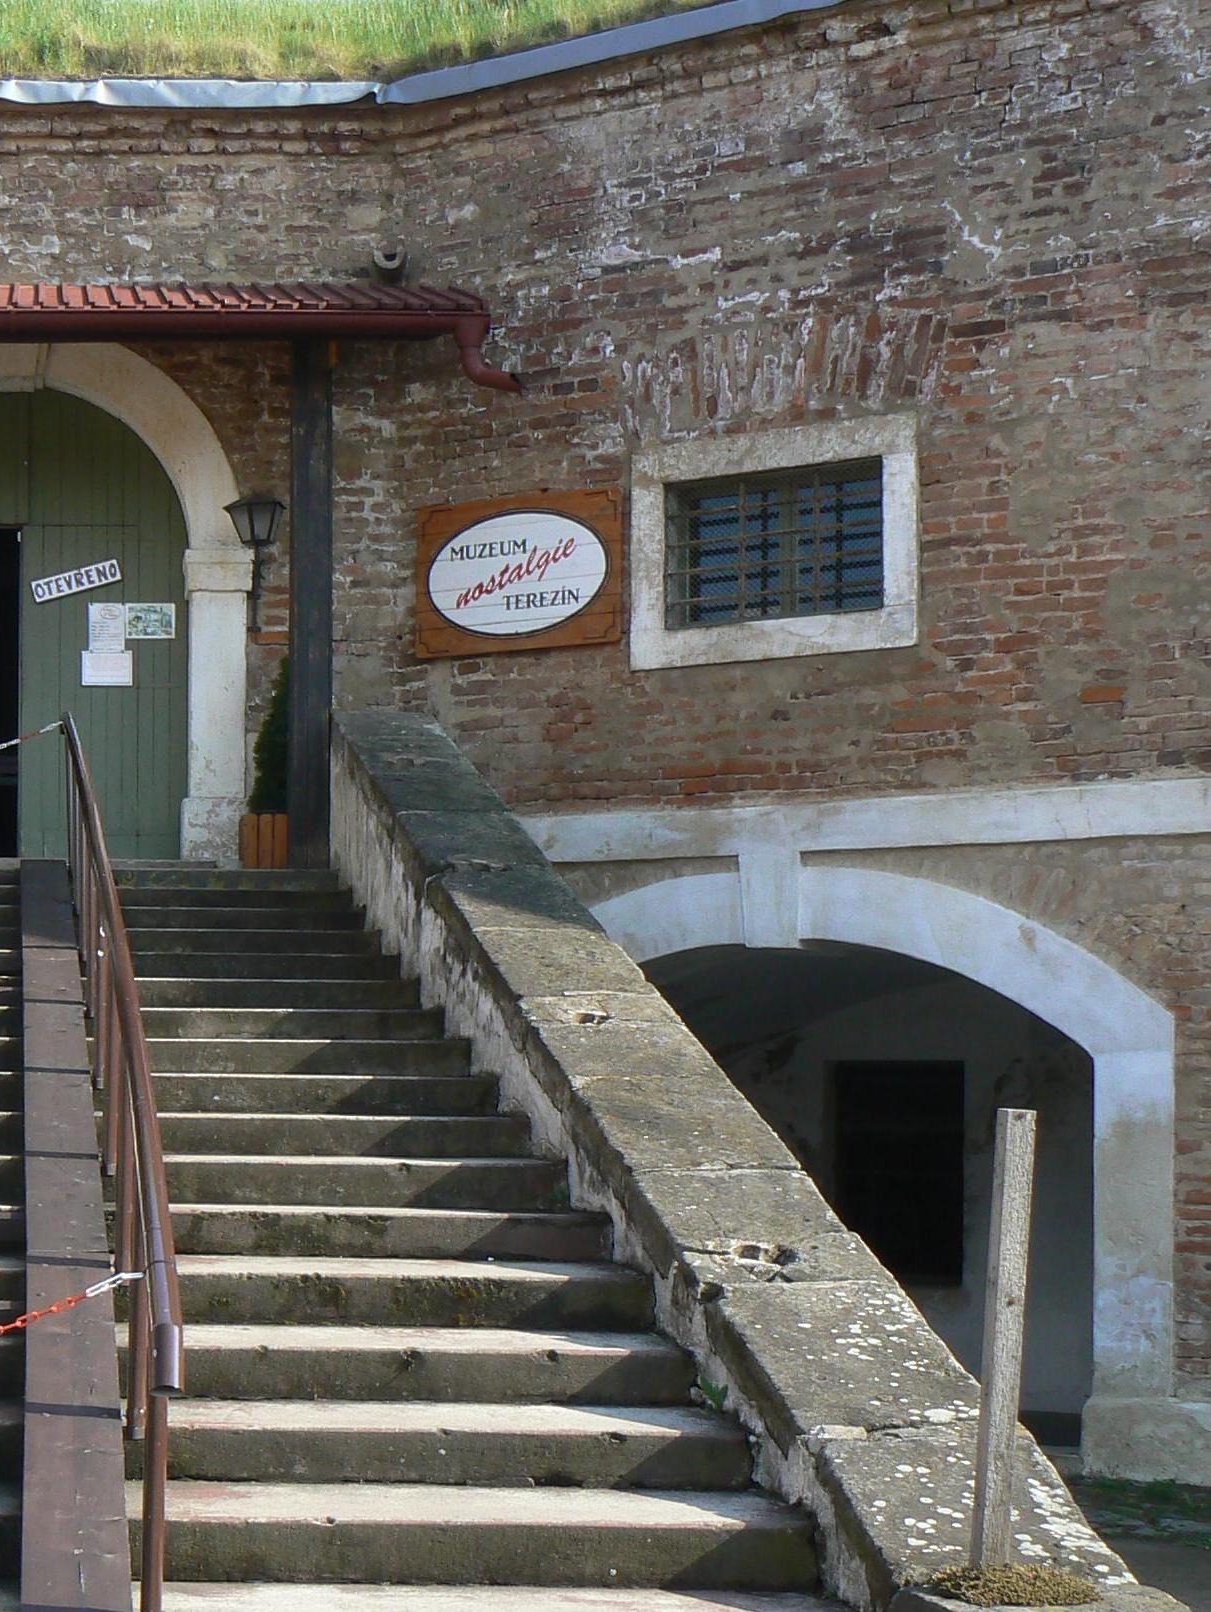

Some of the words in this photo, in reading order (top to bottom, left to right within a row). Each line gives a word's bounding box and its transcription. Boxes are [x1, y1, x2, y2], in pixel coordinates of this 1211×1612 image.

[450, 538, 528, 562] MUZEUM
[455, 537, 577, 609] nostalgie
[503, 586, 580, 611] TEREZÍN
